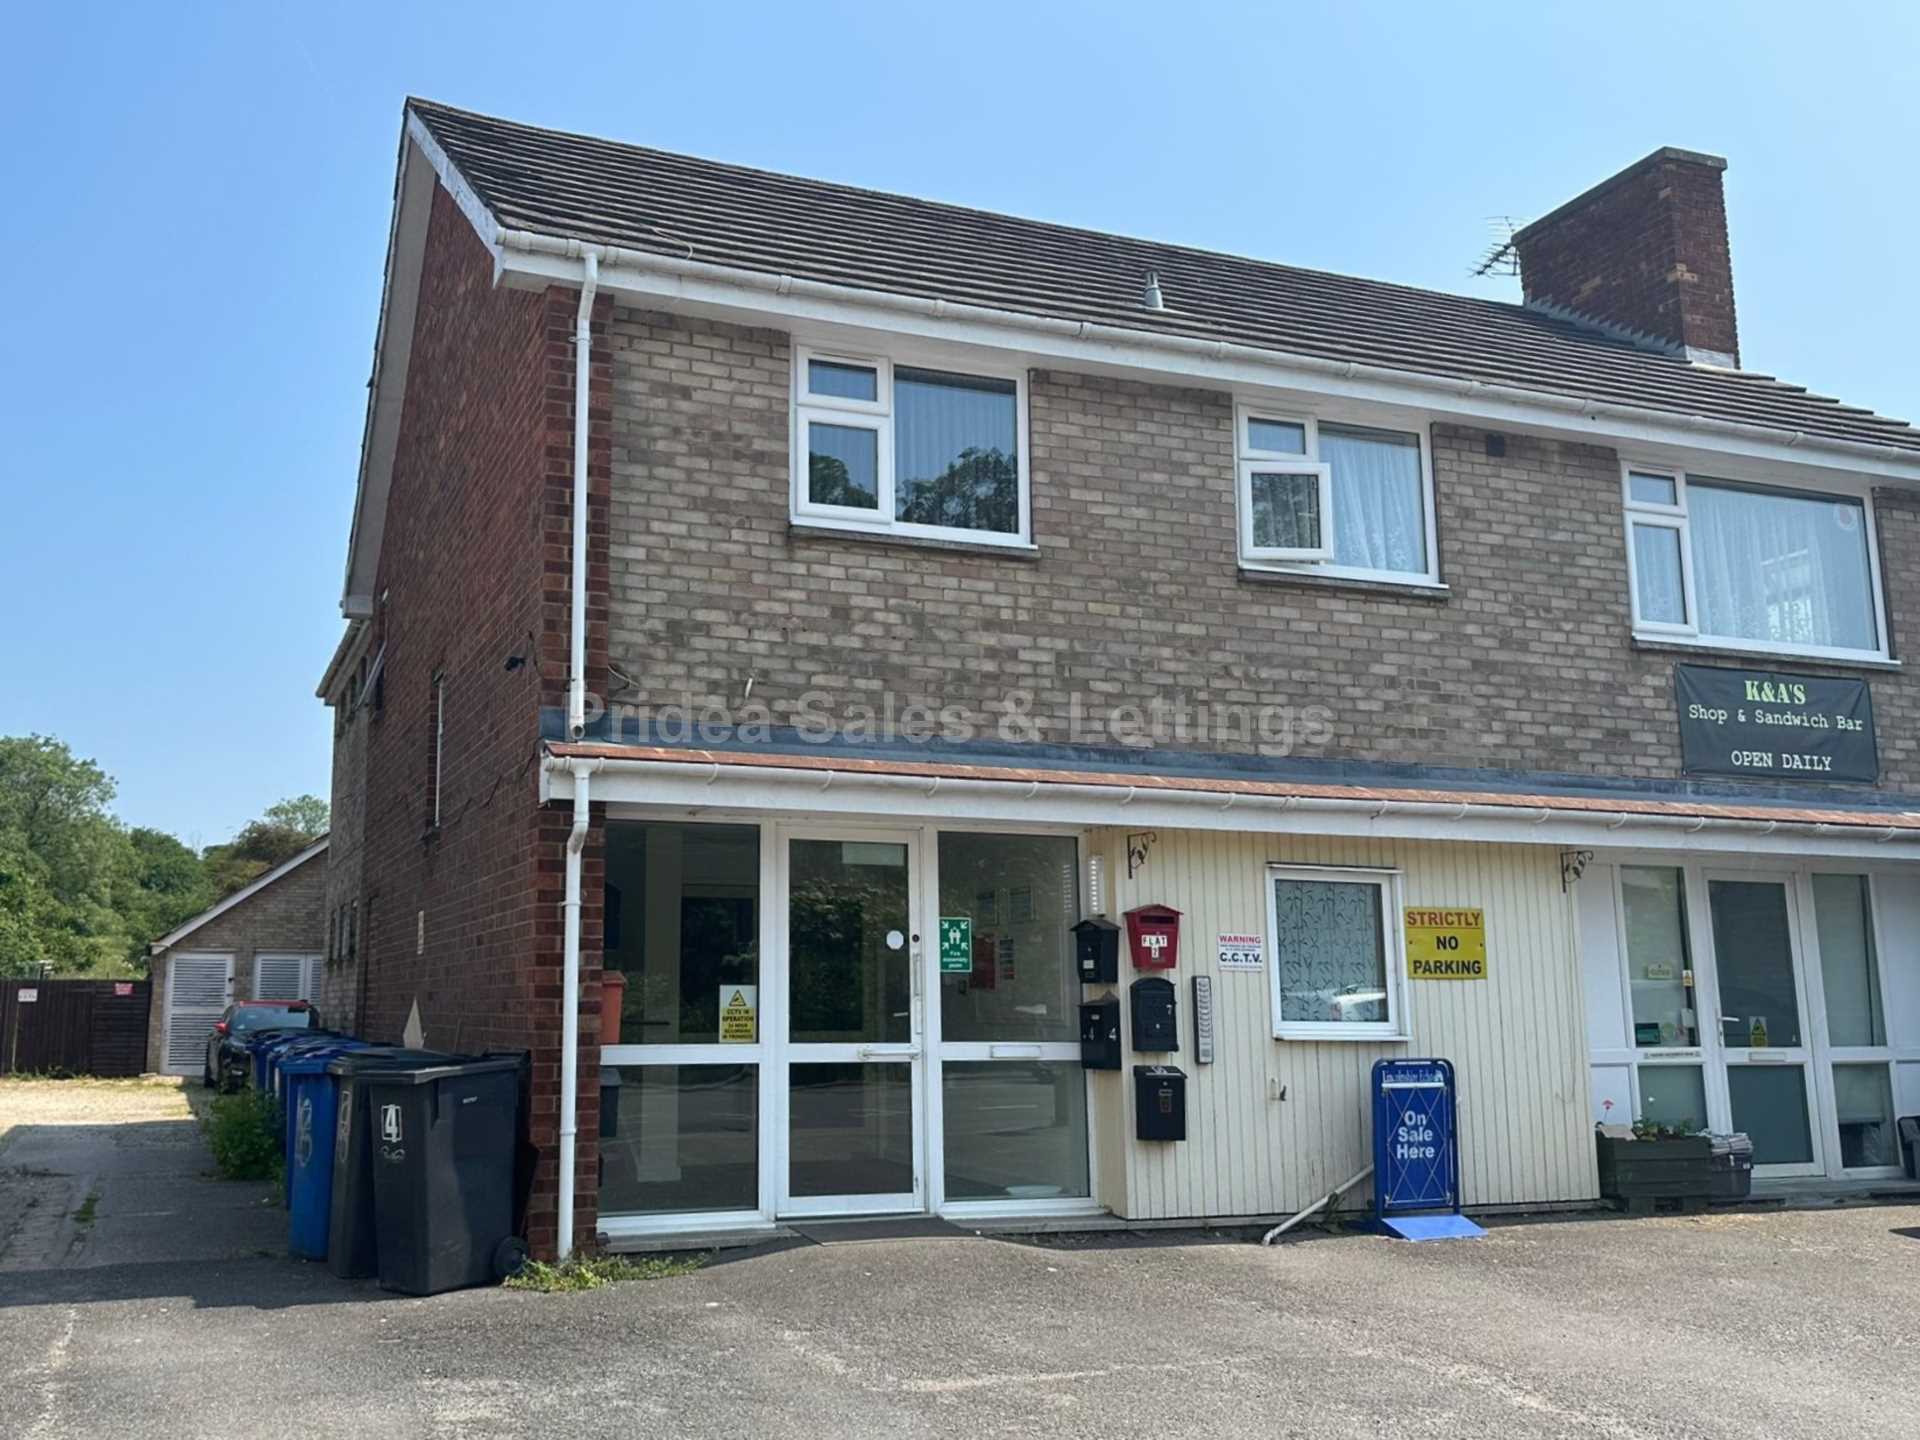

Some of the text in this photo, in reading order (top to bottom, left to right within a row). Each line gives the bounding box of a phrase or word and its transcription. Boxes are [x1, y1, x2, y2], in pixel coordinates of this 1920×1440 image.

[1744, 680, 1807, 705] K&A'S
[1688, 704, 1863, 731] Shop & Sandwich Bar
[1731, 750, 1832, 771] OPEN DAILY
[1407, 911, 1480, 926] STRICTLY
[1142, 937, 1167, 946] FLAT
[1219, 935, 1262, 944] WARNING
[1436, 936, 1459, 950] NO
[1219, 952, 1263, 963] C.C.T.V.
[1413, 960, 1482, 975] PARKING
[1109, 1027, 1117, 1041] 4
[384, 1104, 399, 1142] 4
[1404, 1110, 1427, 1126] On
[1398, 1126, 1433, 1142] Sale
[1396, 1143, 1435, 1159] Here
